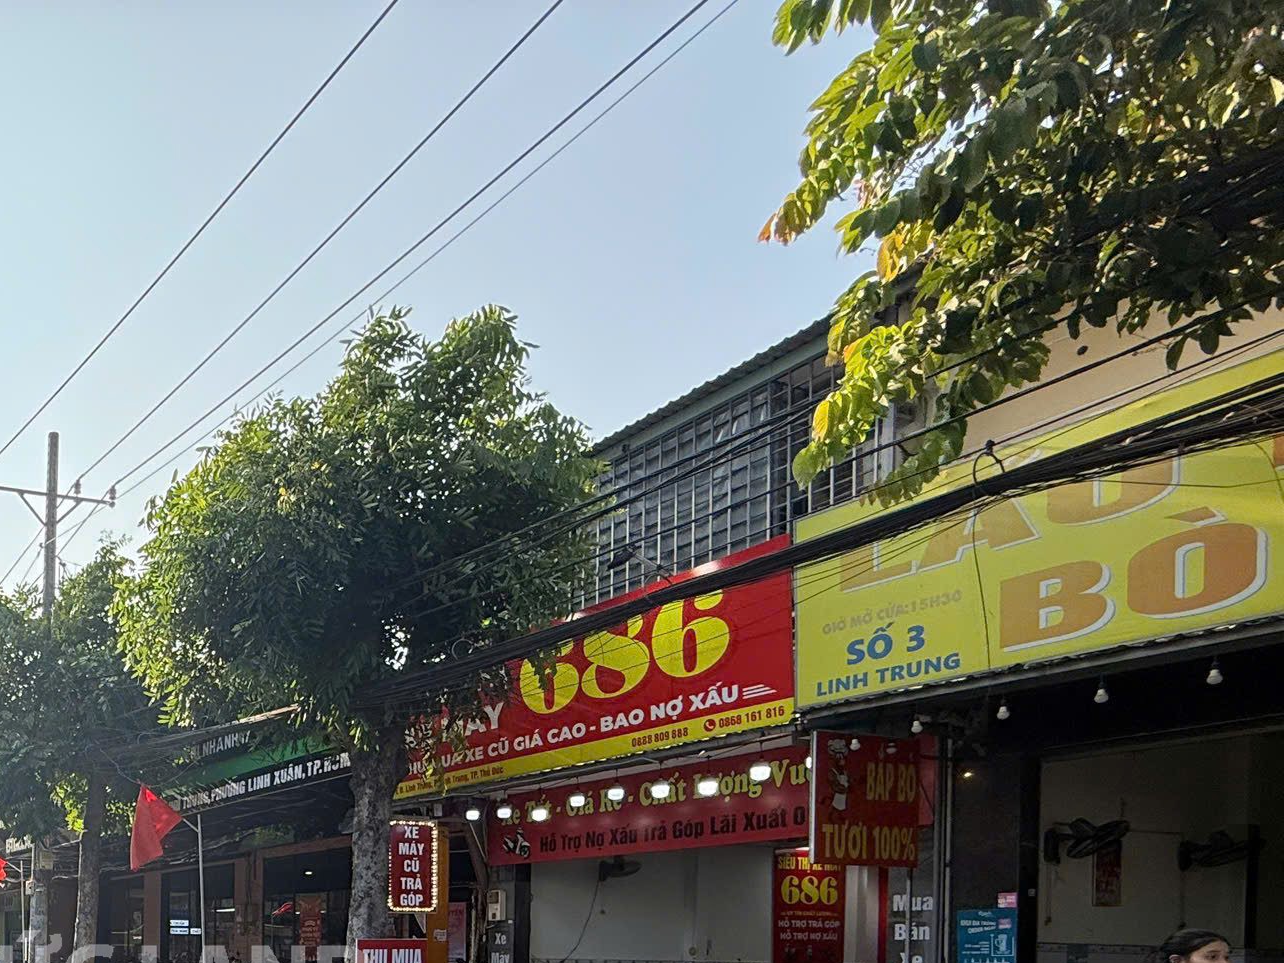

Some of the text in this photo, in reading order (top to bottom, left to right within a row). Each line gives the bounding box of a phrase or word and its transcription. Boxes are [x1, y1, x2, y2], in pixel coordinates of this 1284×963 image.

[1000, 506, 1268, 652] BÒ
[519, 589, 730, 715] 686
[846, 621, 926, 666] SỐ 3
[816, 652, 961, 697] LINH TRUNG
[465, 746, 484, 763] XE
[487, 736, 509, 757] CŨ
[513, 728, 544, 751] GIÁ
[547, 722, 586, 744] CAO
[600, 708, 645, 733] BAO
[650, 698, 684, 721] NỢ
[689, 681, 739, 712] XẤU
[654, 730, 670, 743] 809
[671, 727, 689, 740] 888
[745, 709, 763, 723] 161
[765, 704, 785, 719] 816
[248, 773, 271, 792] LINH
[273, 763, 306, 785] XUÂN,
[404, 826, 419, 839] XE
[672, 818, 704, 840] Góp
[710, 814, 736, 836] Lãi
[822, 819, 916, 861] TƯƠI 100%
[398, 841, 425, 856] MÁY
[404, 857, 420, 873] CŨ
[400, 873, 423, 890] TRẢ
[781, 875, 838, 905] 686
[400, 891, 424, 907] GÓP
[892, 894, 934, 912] Mua
[494, 932, 507, 945] Xe
[894, 922, 930, 940] Bán
